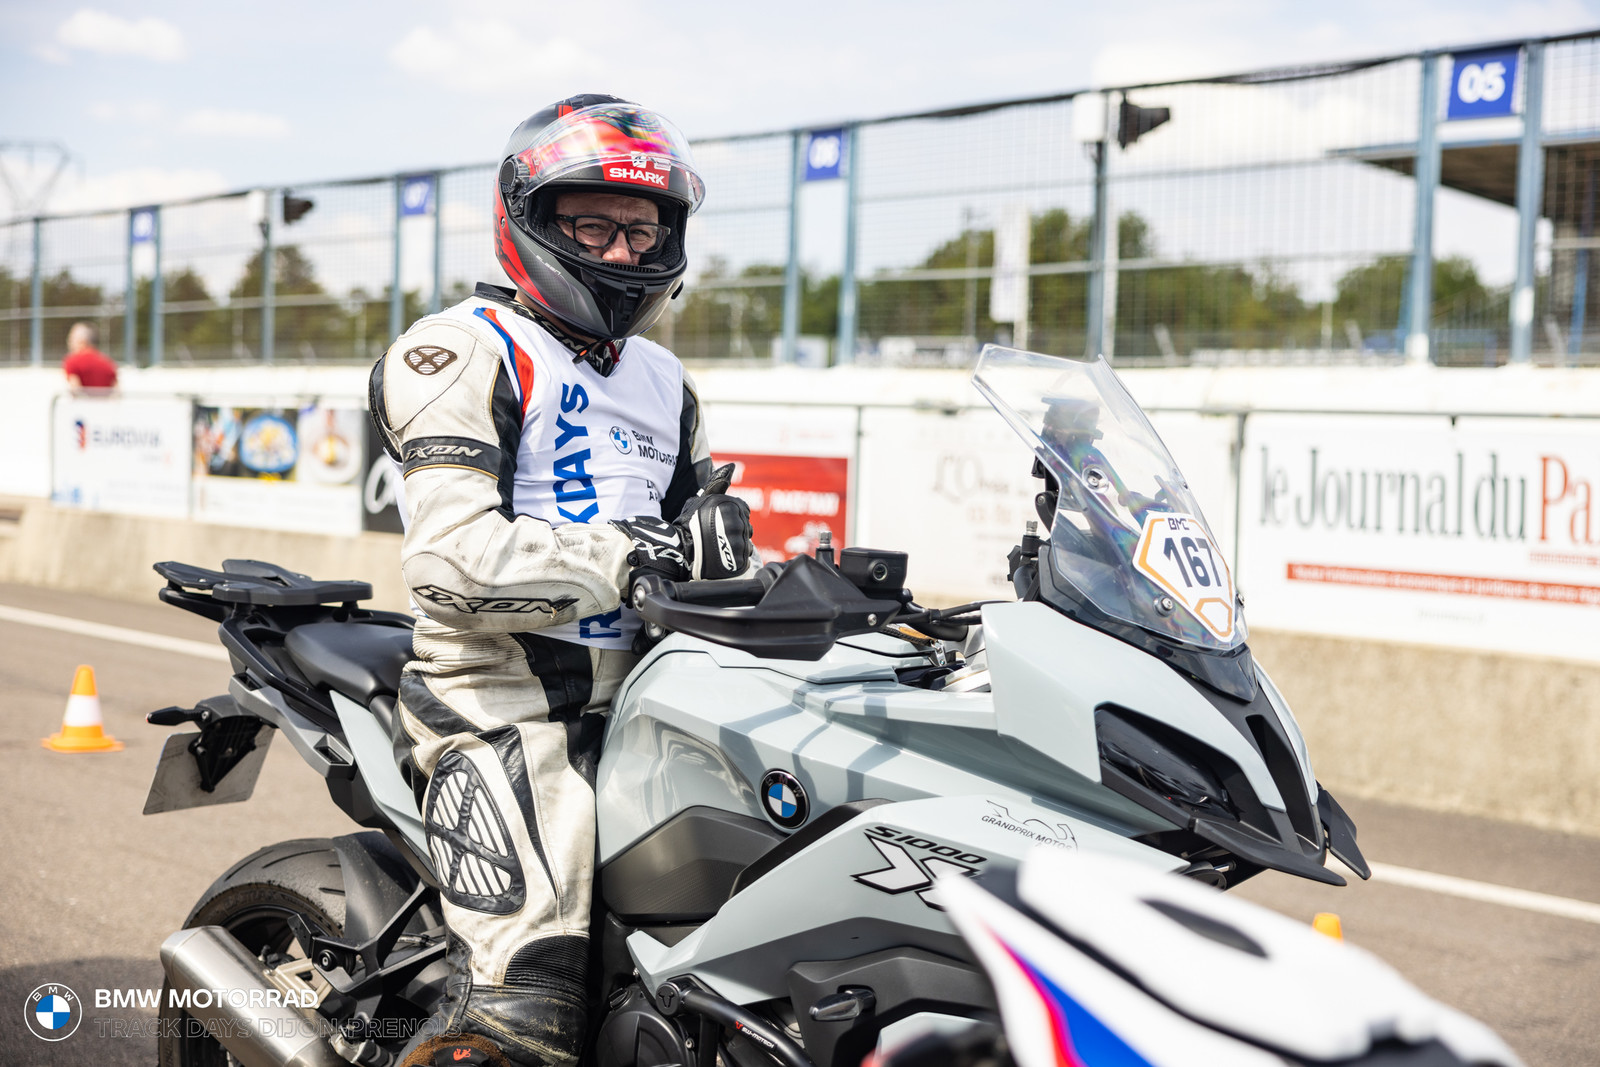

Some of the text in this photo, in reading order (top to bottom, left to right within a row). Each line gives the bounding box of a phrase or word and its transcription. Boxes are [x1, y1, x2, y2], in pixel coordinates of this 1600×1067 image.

[1457, 62, 1506, 104] 05
[609, 167, 665, 186] SHARK
[1259, 445, 1600, 545] le Journal du Pa
[1167, 517, 1190, 531] BMC
[1163, 536, 1222, 588] 167
[864, 826, 987, 864] S1000
[981, 815, 1036, 839] GRANDPRIX
